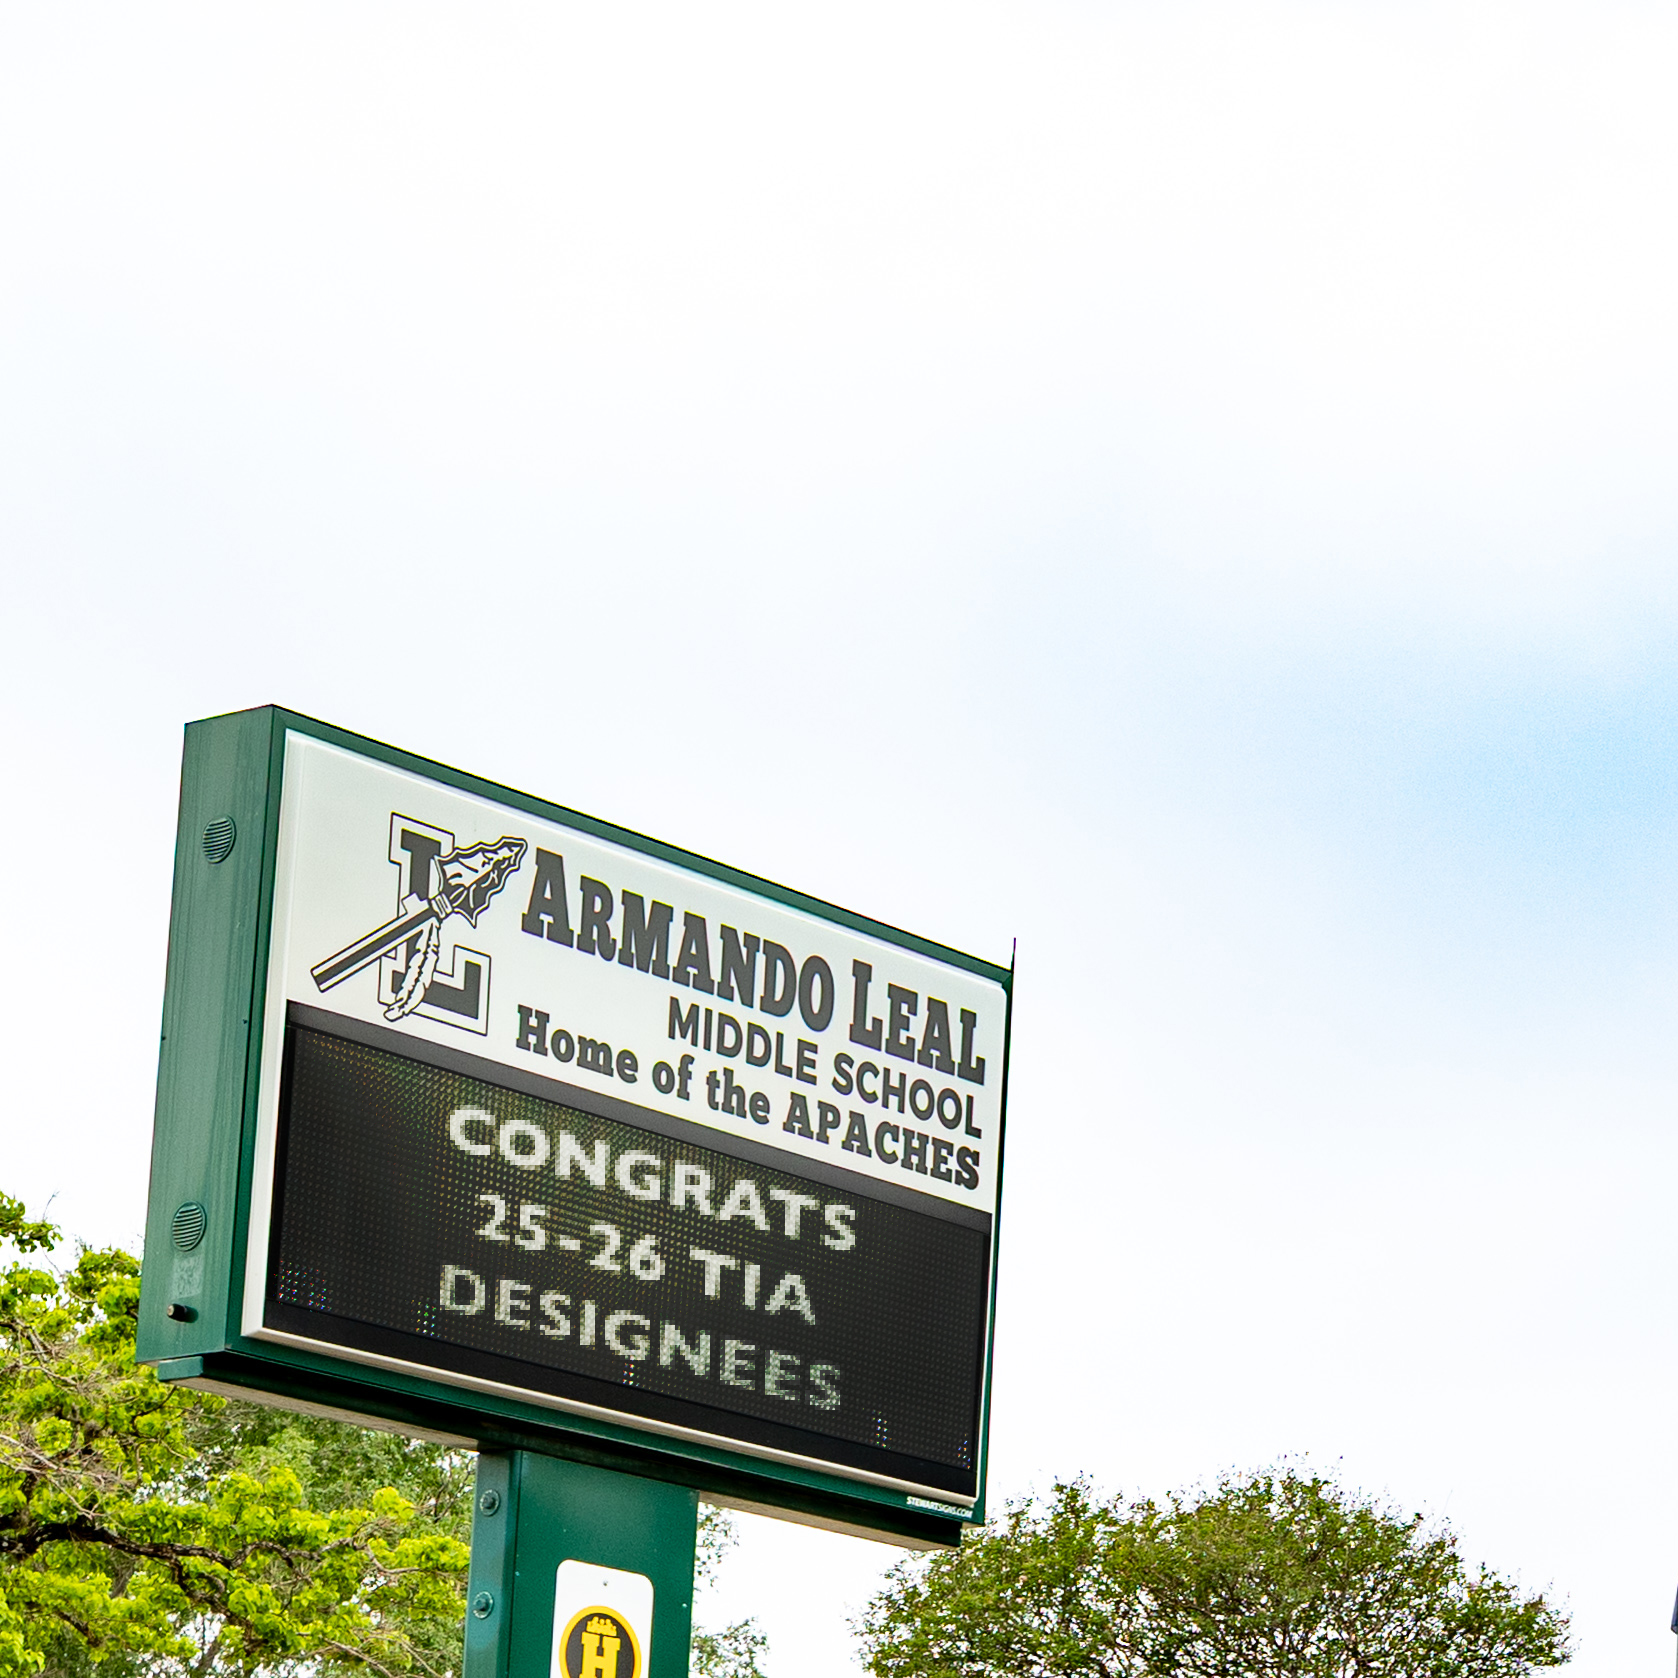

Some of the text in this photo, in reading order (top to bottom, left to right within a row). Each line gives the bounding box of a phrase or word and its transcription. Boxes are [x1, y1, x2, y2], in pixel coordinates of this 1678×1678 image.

[522, 848, 986, 1086] ARMANDO LEAL
[516, 1004, 980, 1191] Home of the APACHES
[669, 996, 983, 1140] MIDDLE SCHOOL
[450, 1105, 856, 1250] CONGRATS
[476, 1194, 815, 1325] 25-26 TIA
[440, 1265, 841, 1410] DESIGNEES
